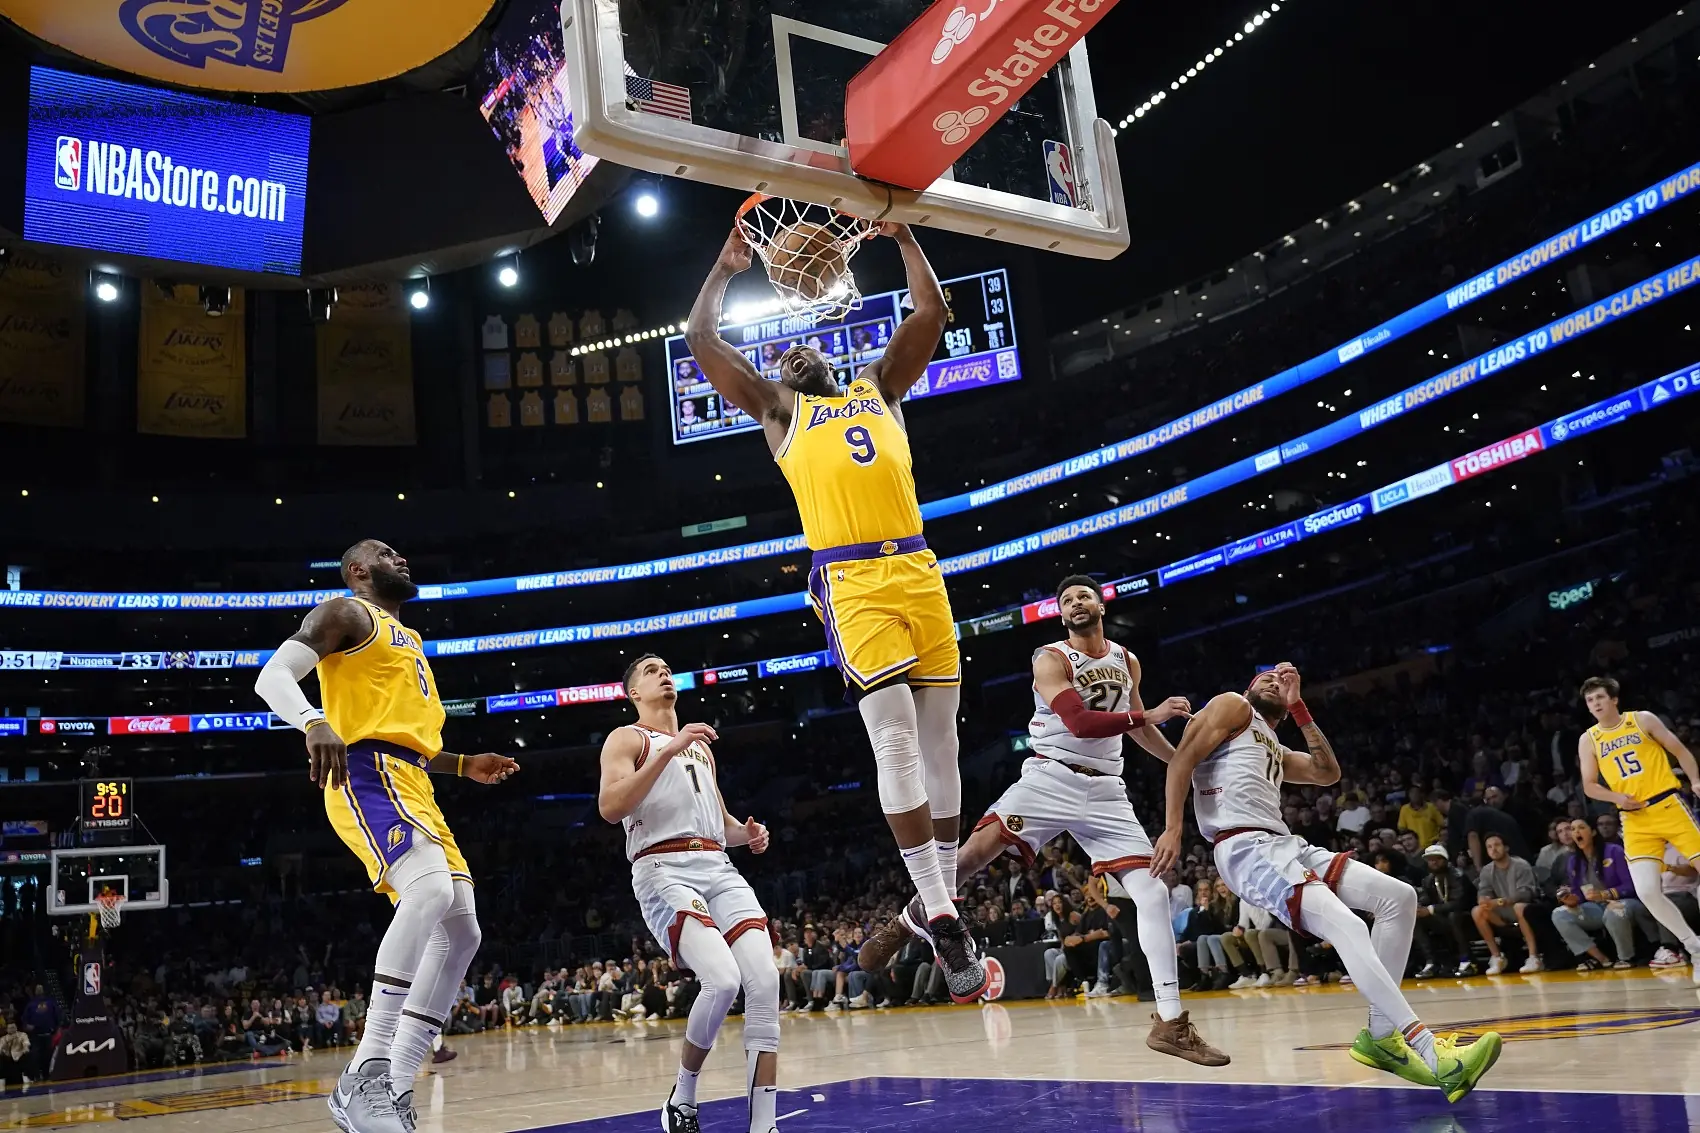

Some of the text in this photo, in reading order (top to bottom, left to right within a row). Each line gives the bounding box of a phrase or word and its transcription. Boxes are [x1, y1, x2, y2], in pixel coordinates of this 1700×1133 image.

[252, 0, 283, 64] GELES
[86, 140, 286, 222] NBAStore.com
[1054, 191, 1068, 205] NBA
[1446, 272, 1494, 309] WHERE
[1497, 228, 1580, 284] DISCOVERY
[1582, 202, 1634, 242] LEADS
[1635, 189, 1658, 214] TO
[988, 276, 1002, 294] 39
[990, 298, 1004, 315] 33
[743, 326, 759, 342] ON
[760, 320, 780, 339] THE
[878, 323, 886, 337] 3
[944, 327, 972, 350] 9:51
[1363, 329, 1391, 348] Health
[1360, 396, 1404, 429] WHERE
[1405, 362, 1478, 409] DISCOVERY
[1480, 341, 1526, 375] LEADS
[1527, 330, 1548, 355] TO
[1550, 280, 1664, 344] WORLD-CLASS
[838, 372, 846, 386] 2
[934, 364, 992, 390] LAKERS
[806, 398, 884, 431] LAKERS
[1568, 398, 1632, 431] crypto.com
[844, 425, 878, 467] 9
[970, 385, 1264, 507] WHERE DISCOVERY LEADS TO WORLD-CLASS HEALTH CARE
[1282, 441, 1308, 460] Health
[1454, 434, 1539, 477] TOSHIBA
[1380, 472, 1448, 503] UCLA Health
[992, 542, 1024, 562] LEADS
[1026, 536, 1040, 551] TO
[1041, 510, 1116, 546] WORLD-CLASS
[1118, 497, 1160, 524] HEALTH
[1160, 486, 1188, 510] CARE
[1304, 502, 1362, 534] Spectrum
[1263, 528, 1294, 546] ULTRA
[516, 536, 808, 590] WHERE DISCOVERY LEADS TO WORLD-CLASS HEALTH CAR
[1164, 554, 1222, 580] AMERICAN EXPRESS
[444, 586, 468, 596] Health
[1116, 578, 1148, 594] TOYOTA
[43, 594, 115, 608] DISCOVERY
[118, 594, 159, 608] LEADS
[162, 595, 178, 608] TO
[180, 594, 266, 608] WORLD-CLASS
[268, 592, 313, 606] HEALTH
[436, 606, 737, 654] WHERE DISCOVERY LEADS TO WORLD-CLASS HEALTH CARE
[50, 658, 58, 668] 2
[70, 656, 113, 667] Nuggets
[131, 655, 150, 668] 33
[235, 652, 260, 665] ARE
[766, 656, 818, 674] Spectrum
[416, 657, 430, 699] 6
[718, 668, 748, 680] TOYOTA
[1076, 668, 1129, 688] DENVER
[524, 694, 554, 704] ULTRA
[560, 684, 624, 703] TOSHIBA
[1088, 683, 1124, 713] 27
[58, 722, 96, 731] TOYOTA
[213, 716, 264, 728] DELTA
[1600, 732, 1642, 758] LAKERS
[1614, 750, 1644, 779] 15
[96, 782, 126, 796] 9:51
[684, 764, 702, 794] 1
[1200, 786, 1223, 796] NUGGETS
[92, 795, 123, 818] 20
[97, 818, 130, 828] TISSOT
[20, 852, 46, 862] TOYOTA
